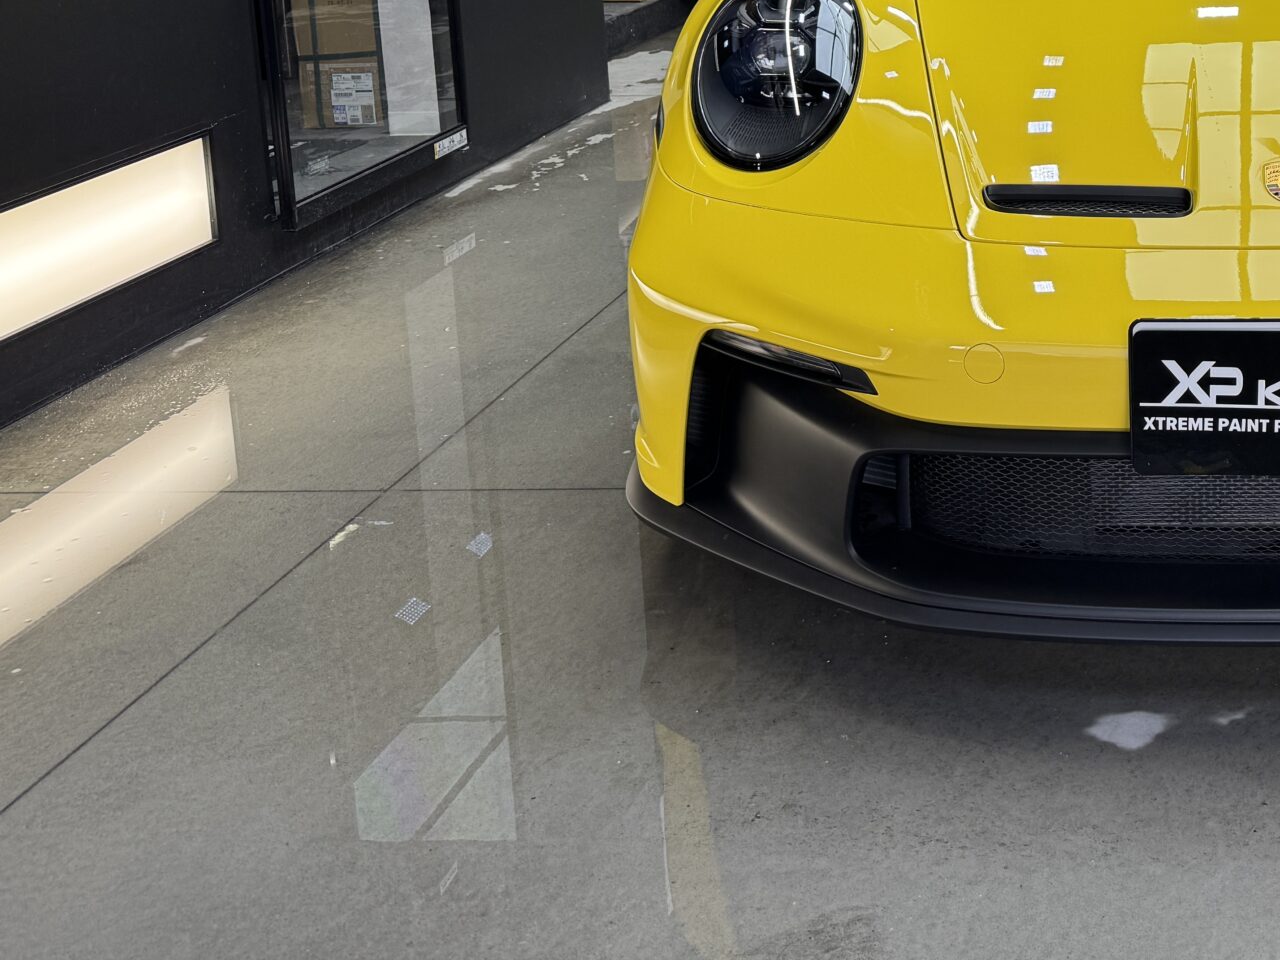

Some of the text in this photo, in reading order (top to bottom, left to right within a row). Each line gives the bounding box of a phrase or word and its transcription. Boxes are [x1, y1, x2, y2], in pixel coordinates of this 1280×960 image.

[1161, 359, 1244, 405] XP
[1143, 416, 1214, 432] XTREME
[1217, 417, 1270, 434] PAINT
